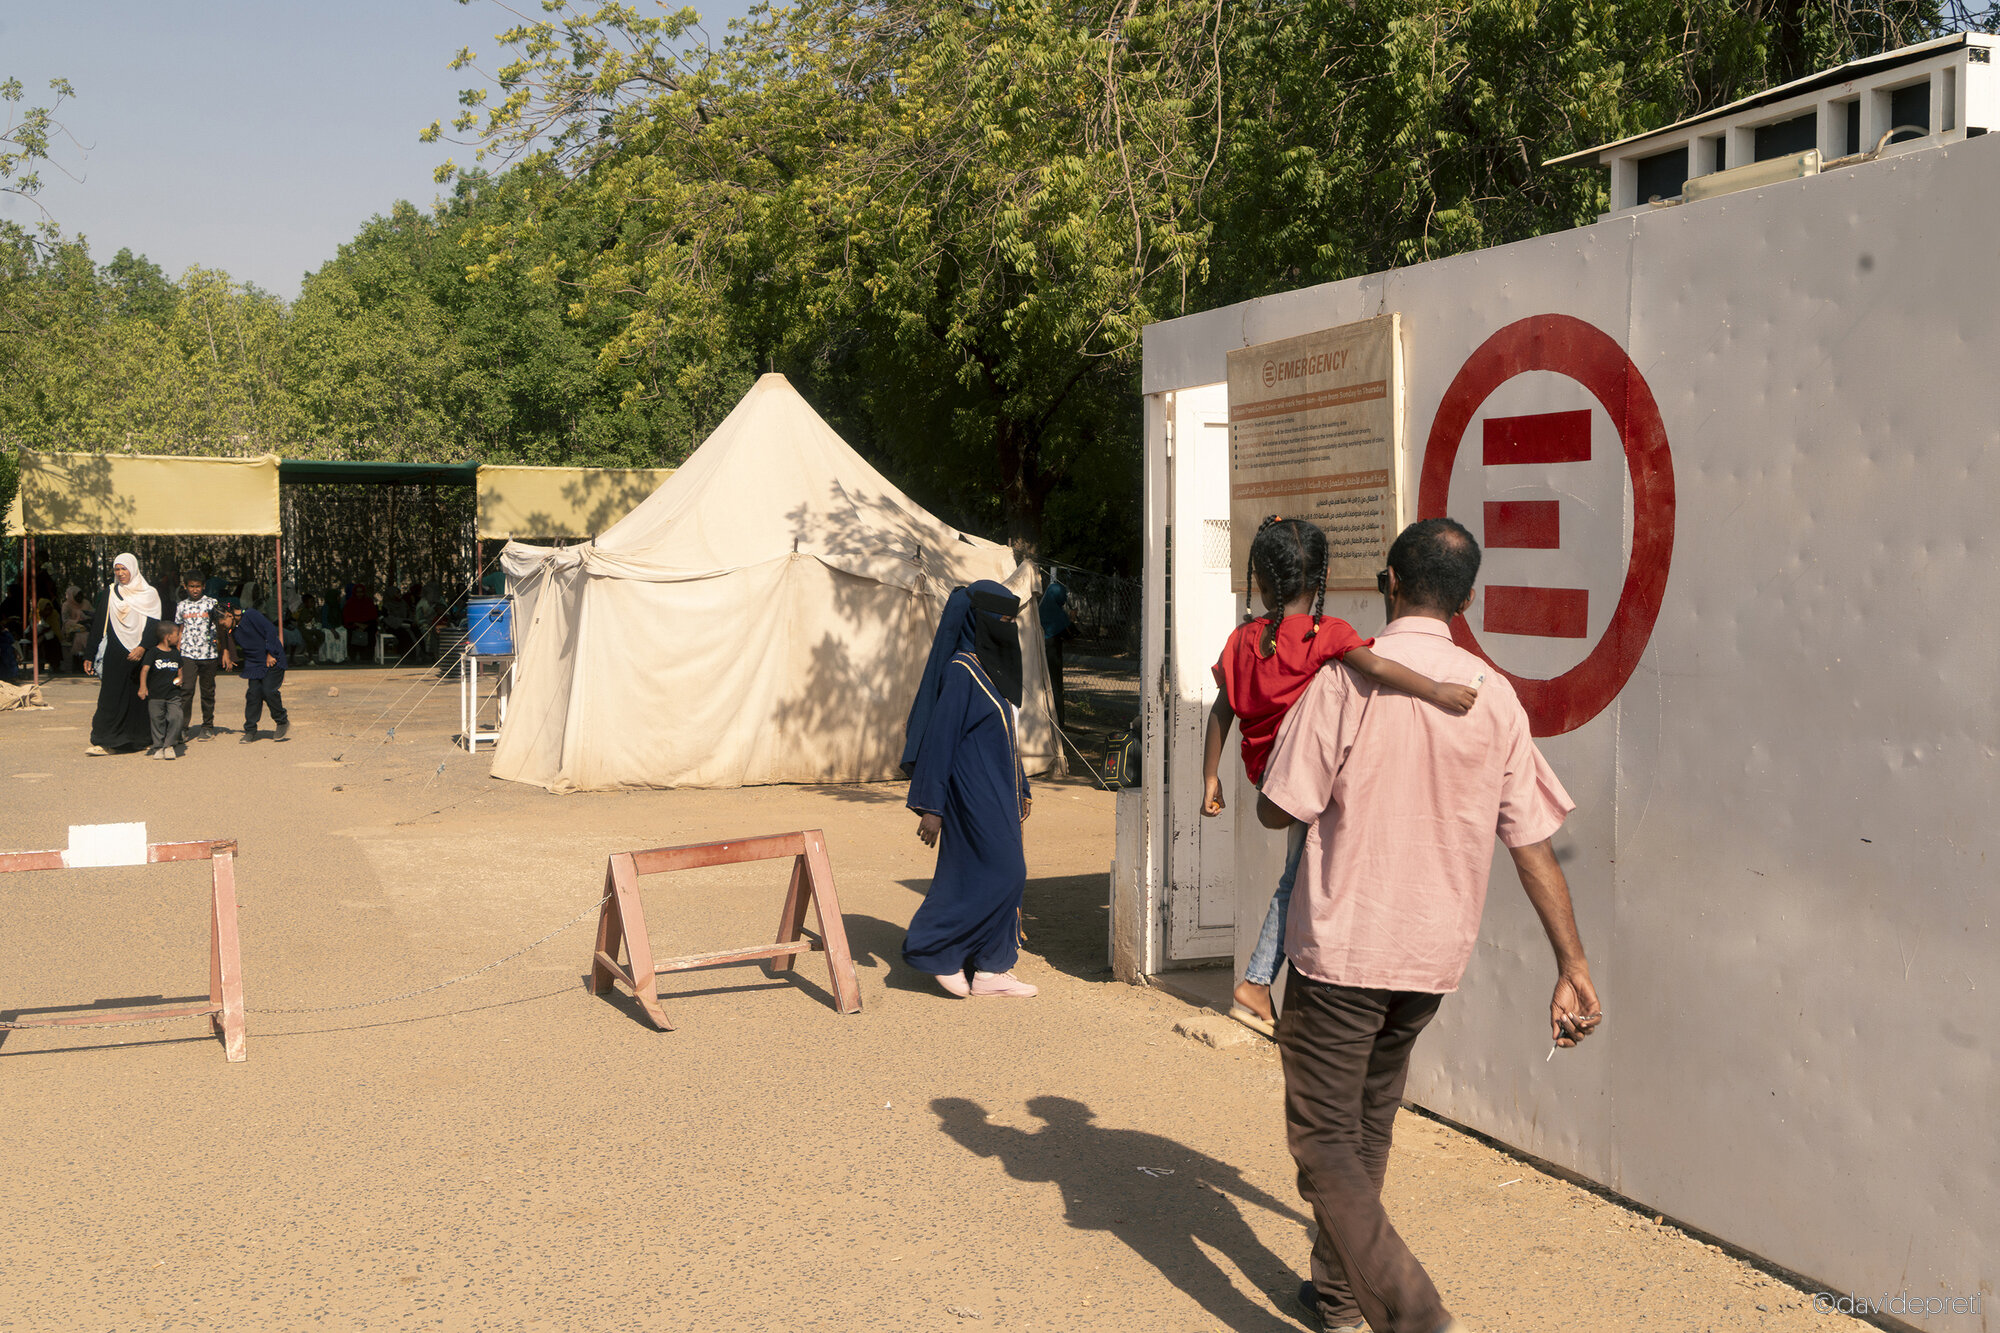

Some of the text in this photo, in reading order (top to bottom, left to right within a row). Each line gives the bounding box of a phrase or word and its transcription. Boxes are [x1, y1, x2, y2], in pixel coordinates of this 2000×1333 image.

[1278, 349, 1348, 382] EMERGENCY
[1339, 389, 1355, 399] Sunday
[1362, 384, 1384, 396] Thursday
